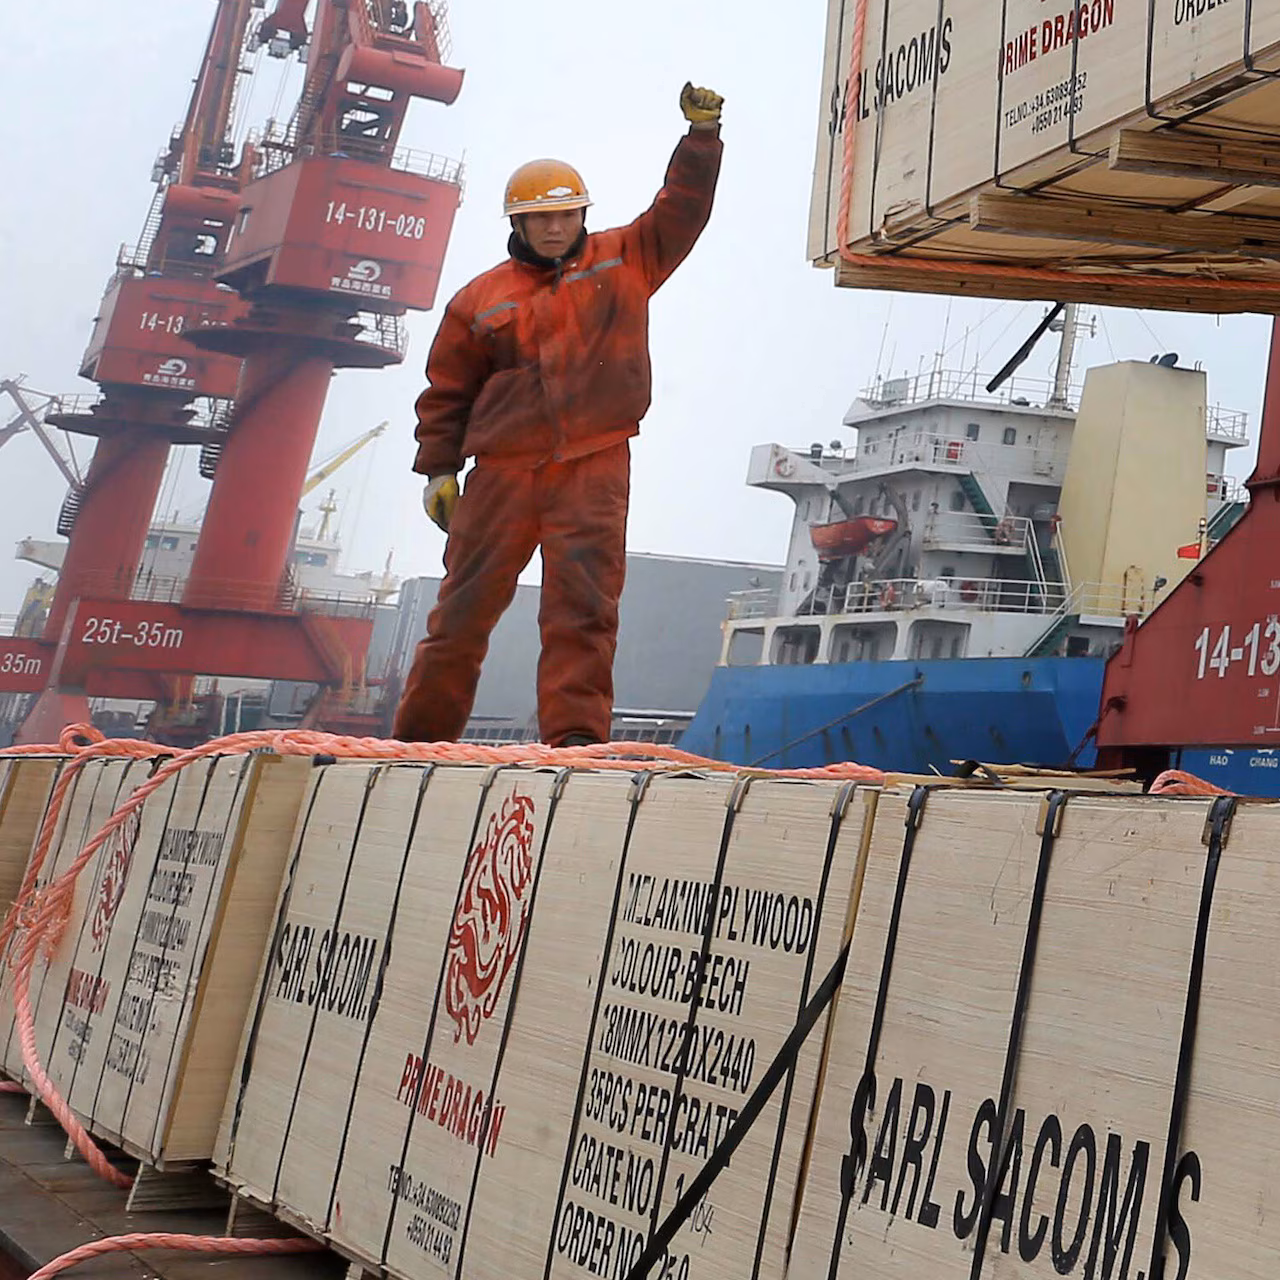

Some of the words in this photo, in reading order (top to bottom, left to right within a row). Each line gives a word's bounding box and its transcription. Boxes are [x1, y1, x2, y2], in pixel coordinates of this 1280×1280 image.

[874, 17, 953, 112] SACOMS
[326, 201, 426, 240] 14-131-026
[82, 617, 183, 649] 25t-35m
[716, 885, 813, 955] PLYWOOD
[396, 1053, 444, 1121] PRME
[586, 1068, 633, 1133] 35PCS
[630, 1083, 671, 1146] PER
[573, 1133, 624, 1205] CRATE
[840, 1070, 951, 1229] SARL
[558, 1201, 616, 1278] ORDER
